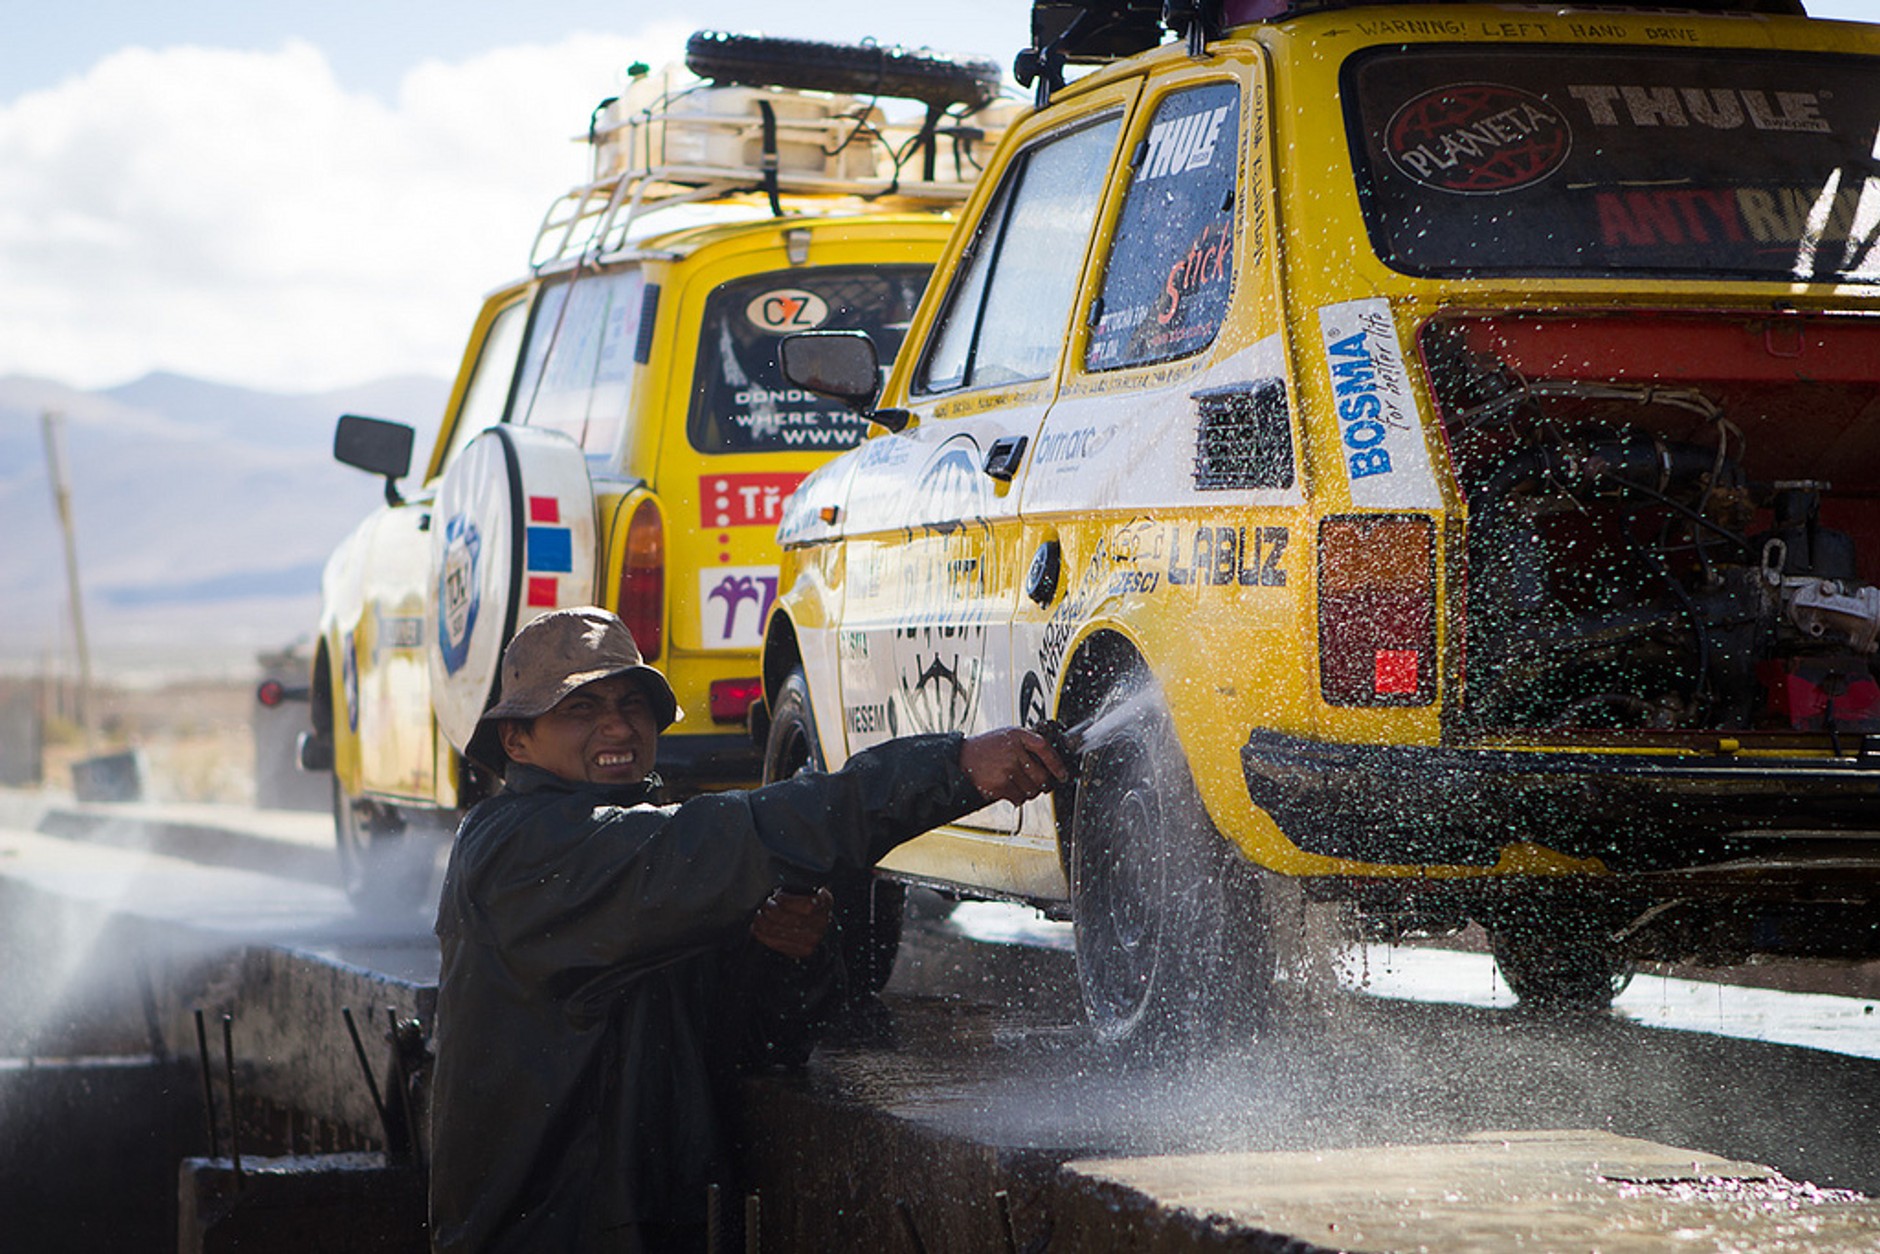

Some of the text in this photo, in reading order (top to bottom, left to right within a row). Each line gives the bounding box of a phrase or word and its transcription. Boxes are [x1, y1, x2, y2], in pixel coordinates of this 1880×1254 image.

[1357, 21, 1699, 41] WARNING! LEFT HAND DRIVE
[1567, 84, 1832, 133] THULE
[1134, 106, 1229, 183] THULE
[1401, 102, 1557, 178] PLANETA
[763, 297, 812, 326] CZ
[735, 390, 817, 405] DONDE
[1358, 312, 1411, 431] for better life
[736, 411, 819, 427] WHERE
[1328, 331, 1393, 480] BOSMA
[1168, 526, 1289, 586] LABUZ
